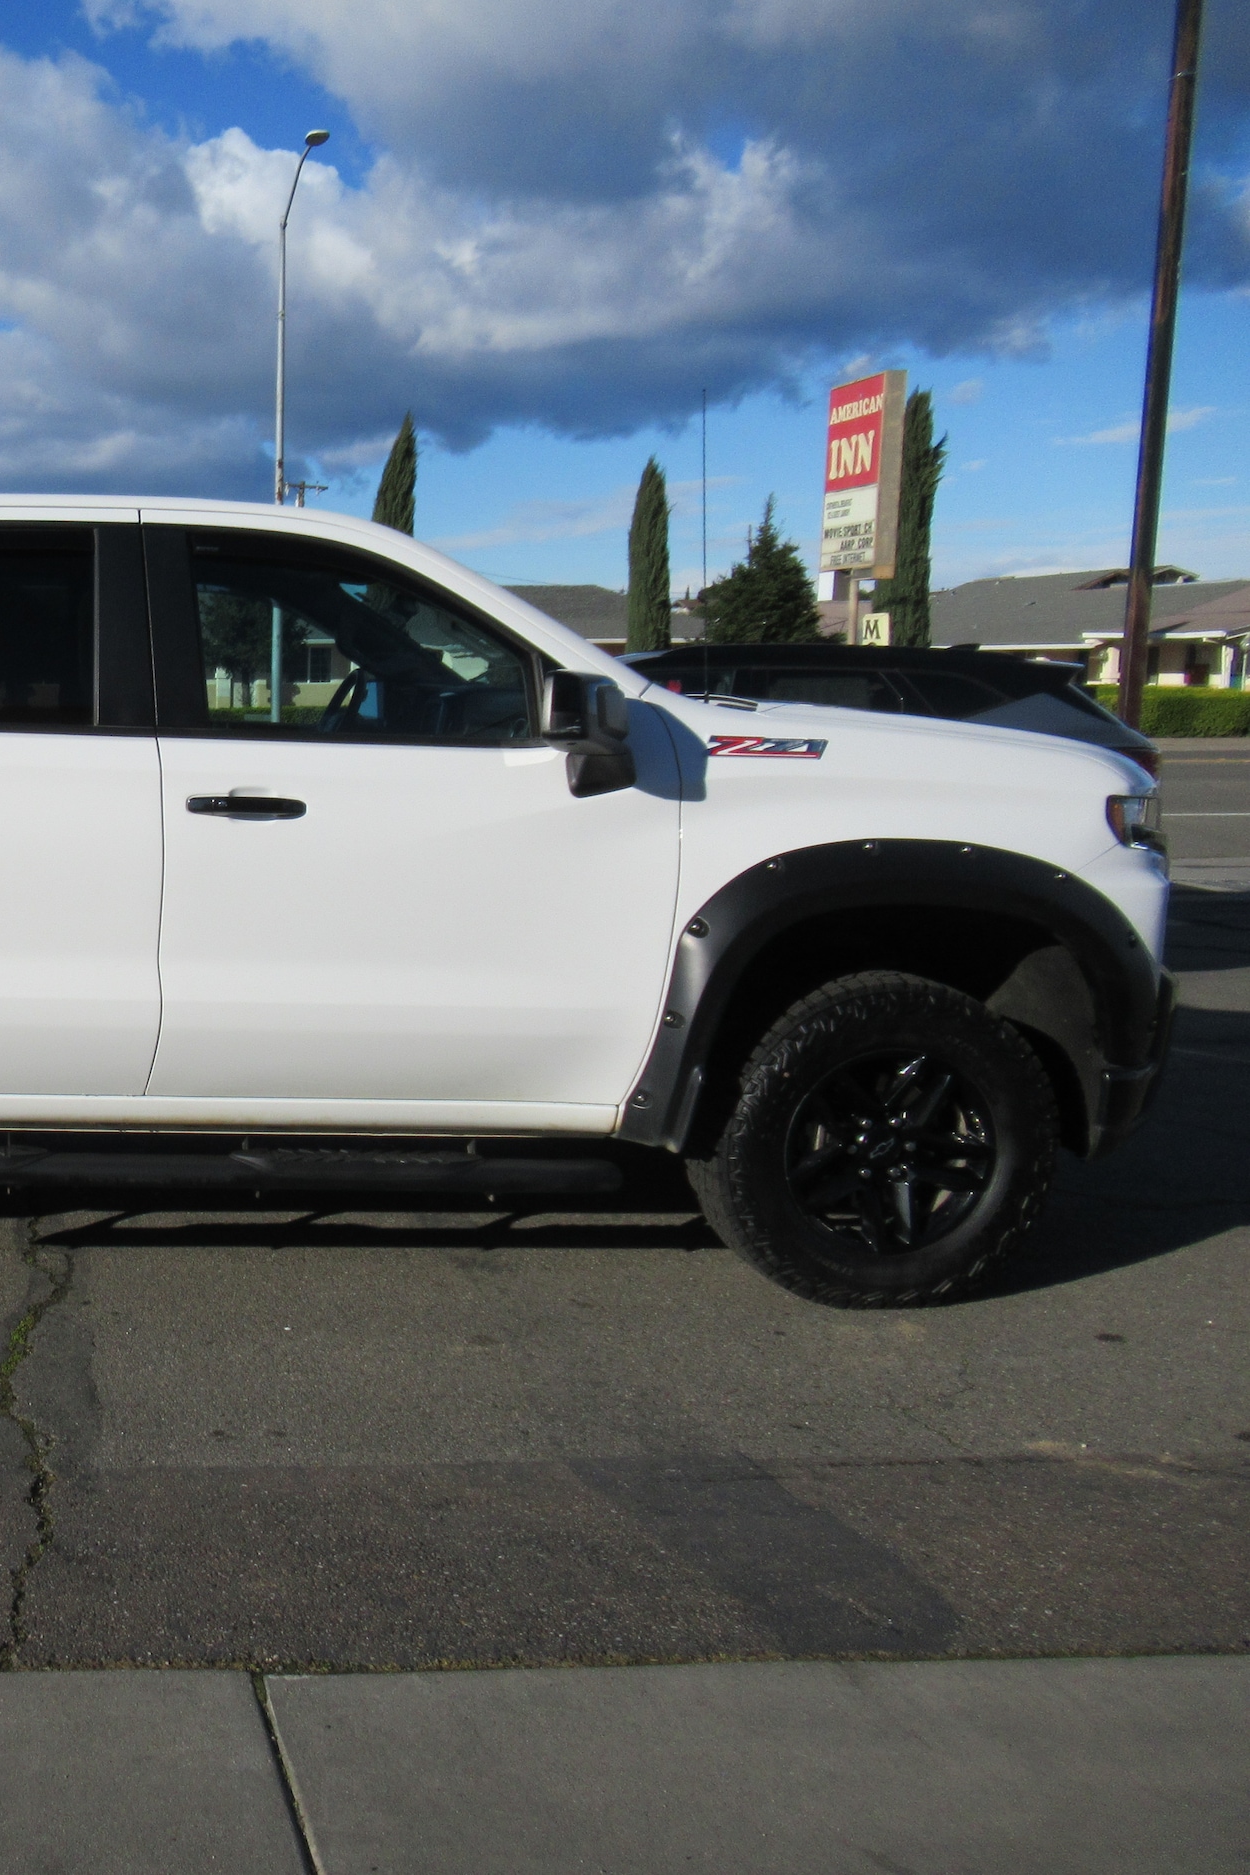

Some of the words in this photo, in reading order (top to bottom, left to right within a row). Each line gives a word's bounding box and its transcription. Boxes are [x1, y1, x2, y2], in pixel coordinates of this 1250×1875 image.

[830, 393, 884, 425] AMERICAN
[829, 430, 875, 480] INN
[863, 619, 881, 644] M
